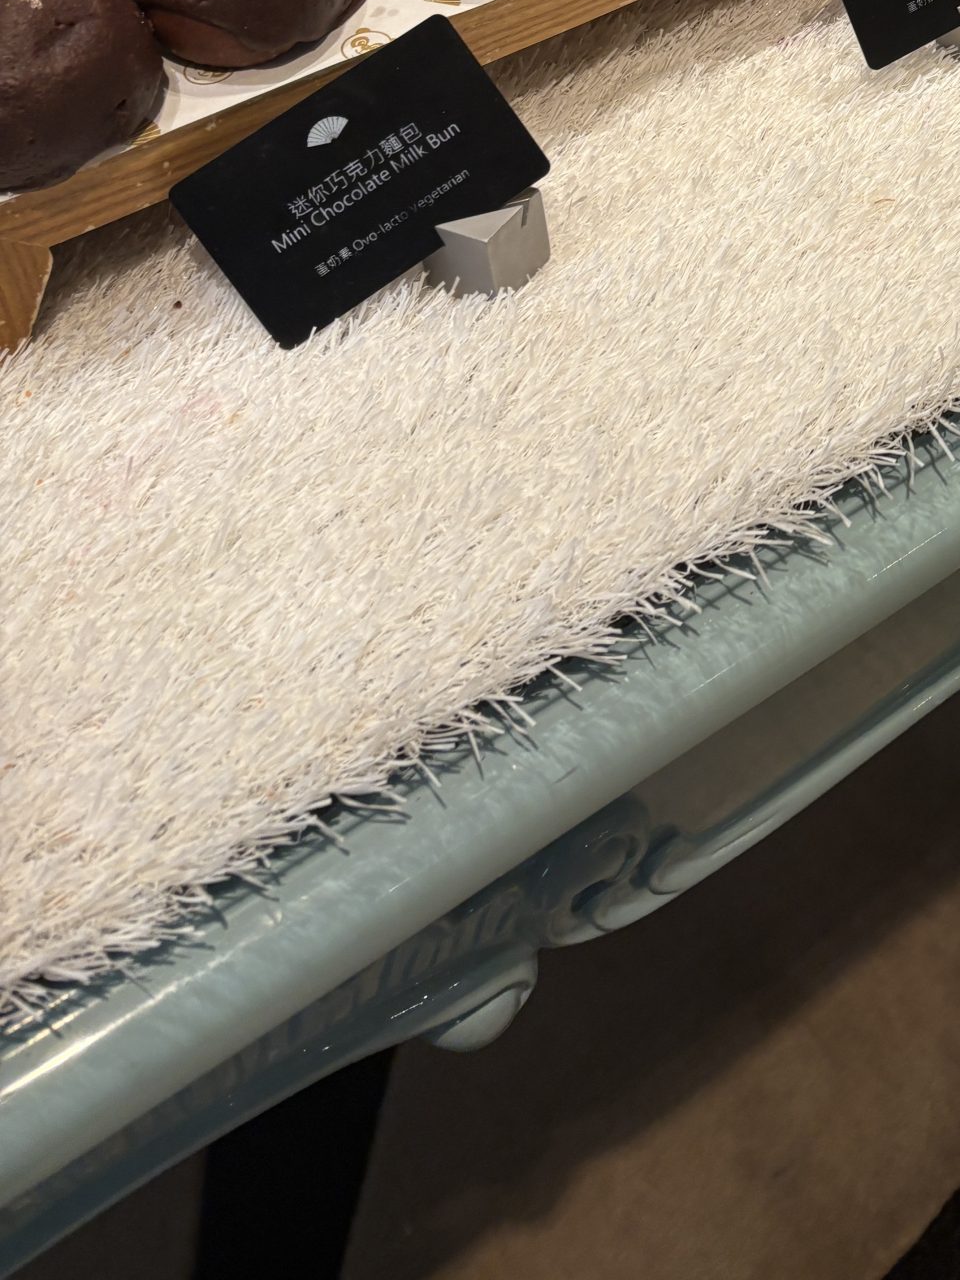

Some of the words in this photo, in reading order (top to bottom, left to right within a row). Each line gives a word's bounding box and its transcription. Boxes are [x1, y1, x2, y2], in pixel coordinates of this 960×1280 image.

[271, 220, 311, 253] Mini
[310, 170, 392, 226] Chocolate
[390, 141, 429, 174] Milk
[426, 121, 461, 151] Bun
[287, 122, 422, 220] 迷你巧克力麵包
[314, 246, 353, 277] 蛋奶素
[352, 210, 409, 251] Ovo-lacto
[409, 168, 471, 212] vegetarian
